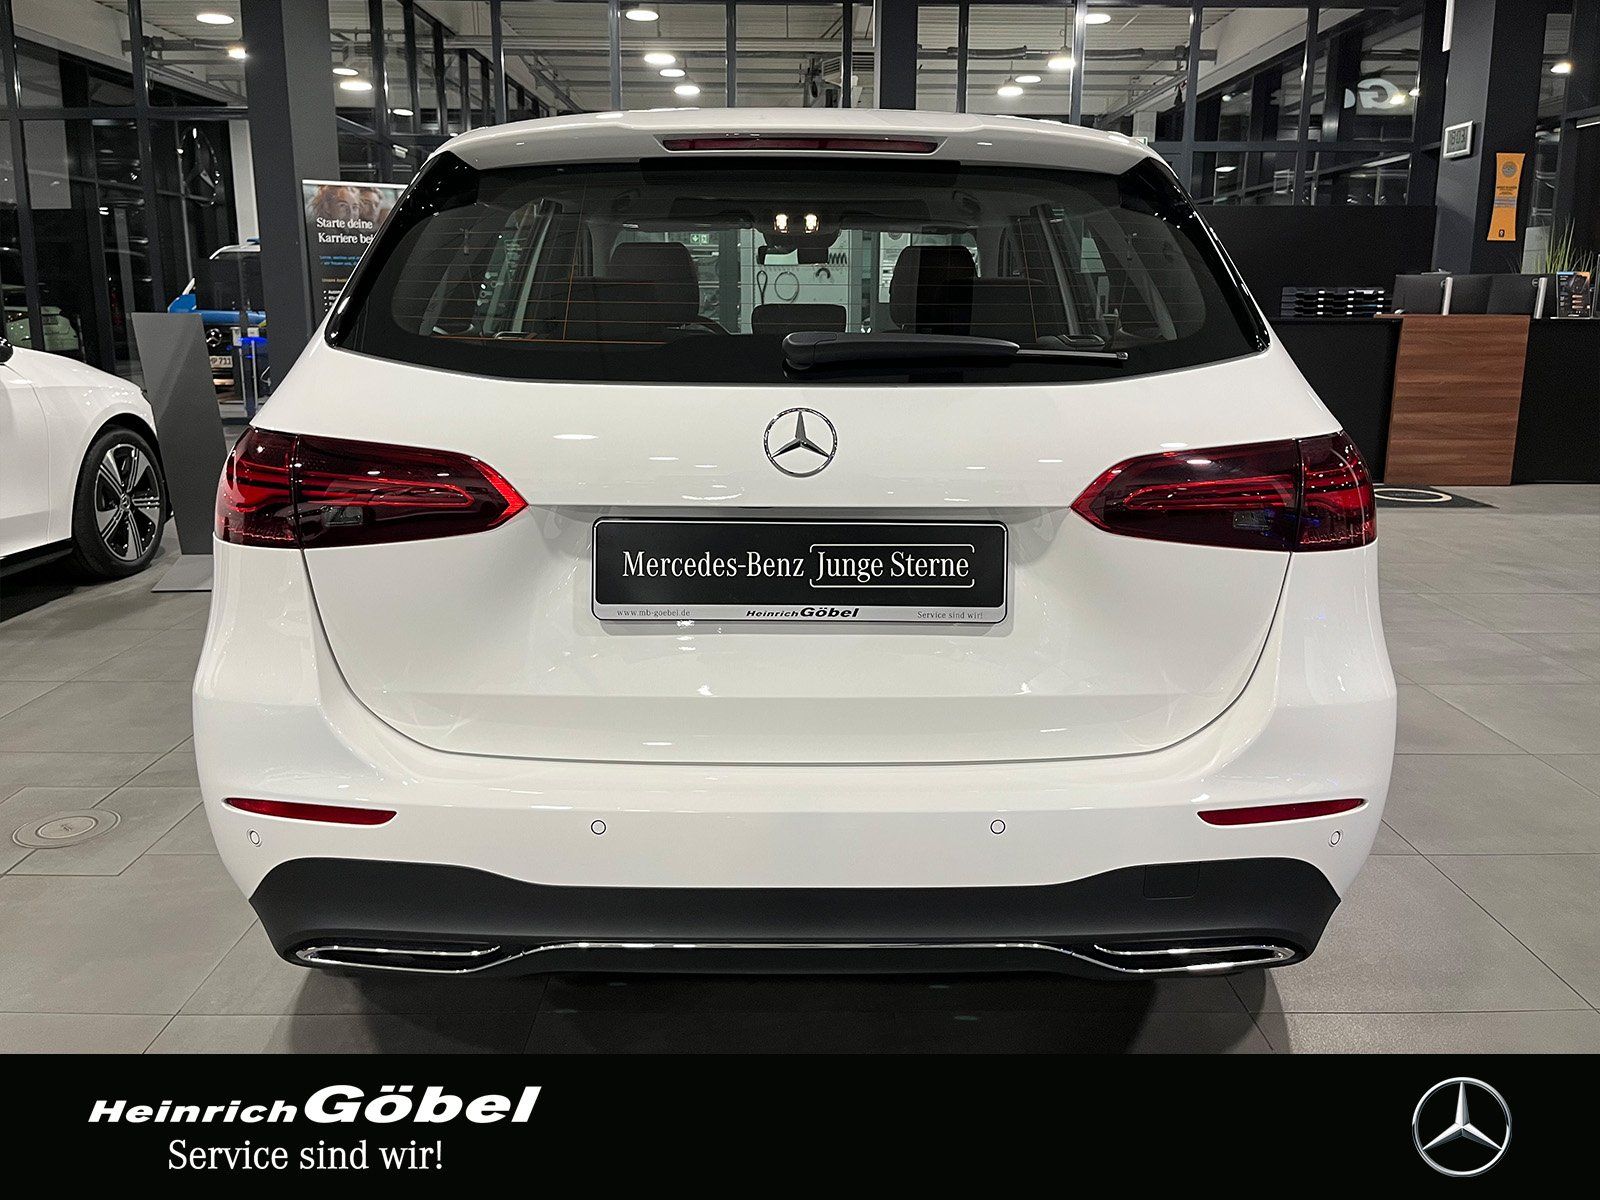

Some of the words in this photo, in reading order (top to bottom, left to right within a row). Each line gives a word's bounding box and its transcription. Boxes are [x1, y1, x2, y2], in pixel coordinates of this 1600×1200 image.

[316, 217, 346, 229] Starte
[347, 218, 373, 230] deine
[318, 232, 358, 244] Karriere
[622, 551, 805, 578] Mercedes-Benz
[816, 551, 884, 583] Junge
[890, 551, 970, 578] Sterne
[616, 608, 691, 618] www.mb-goebel.de
[917, 611, 946, 620] Service
[948, 611, 964, 620] sind
